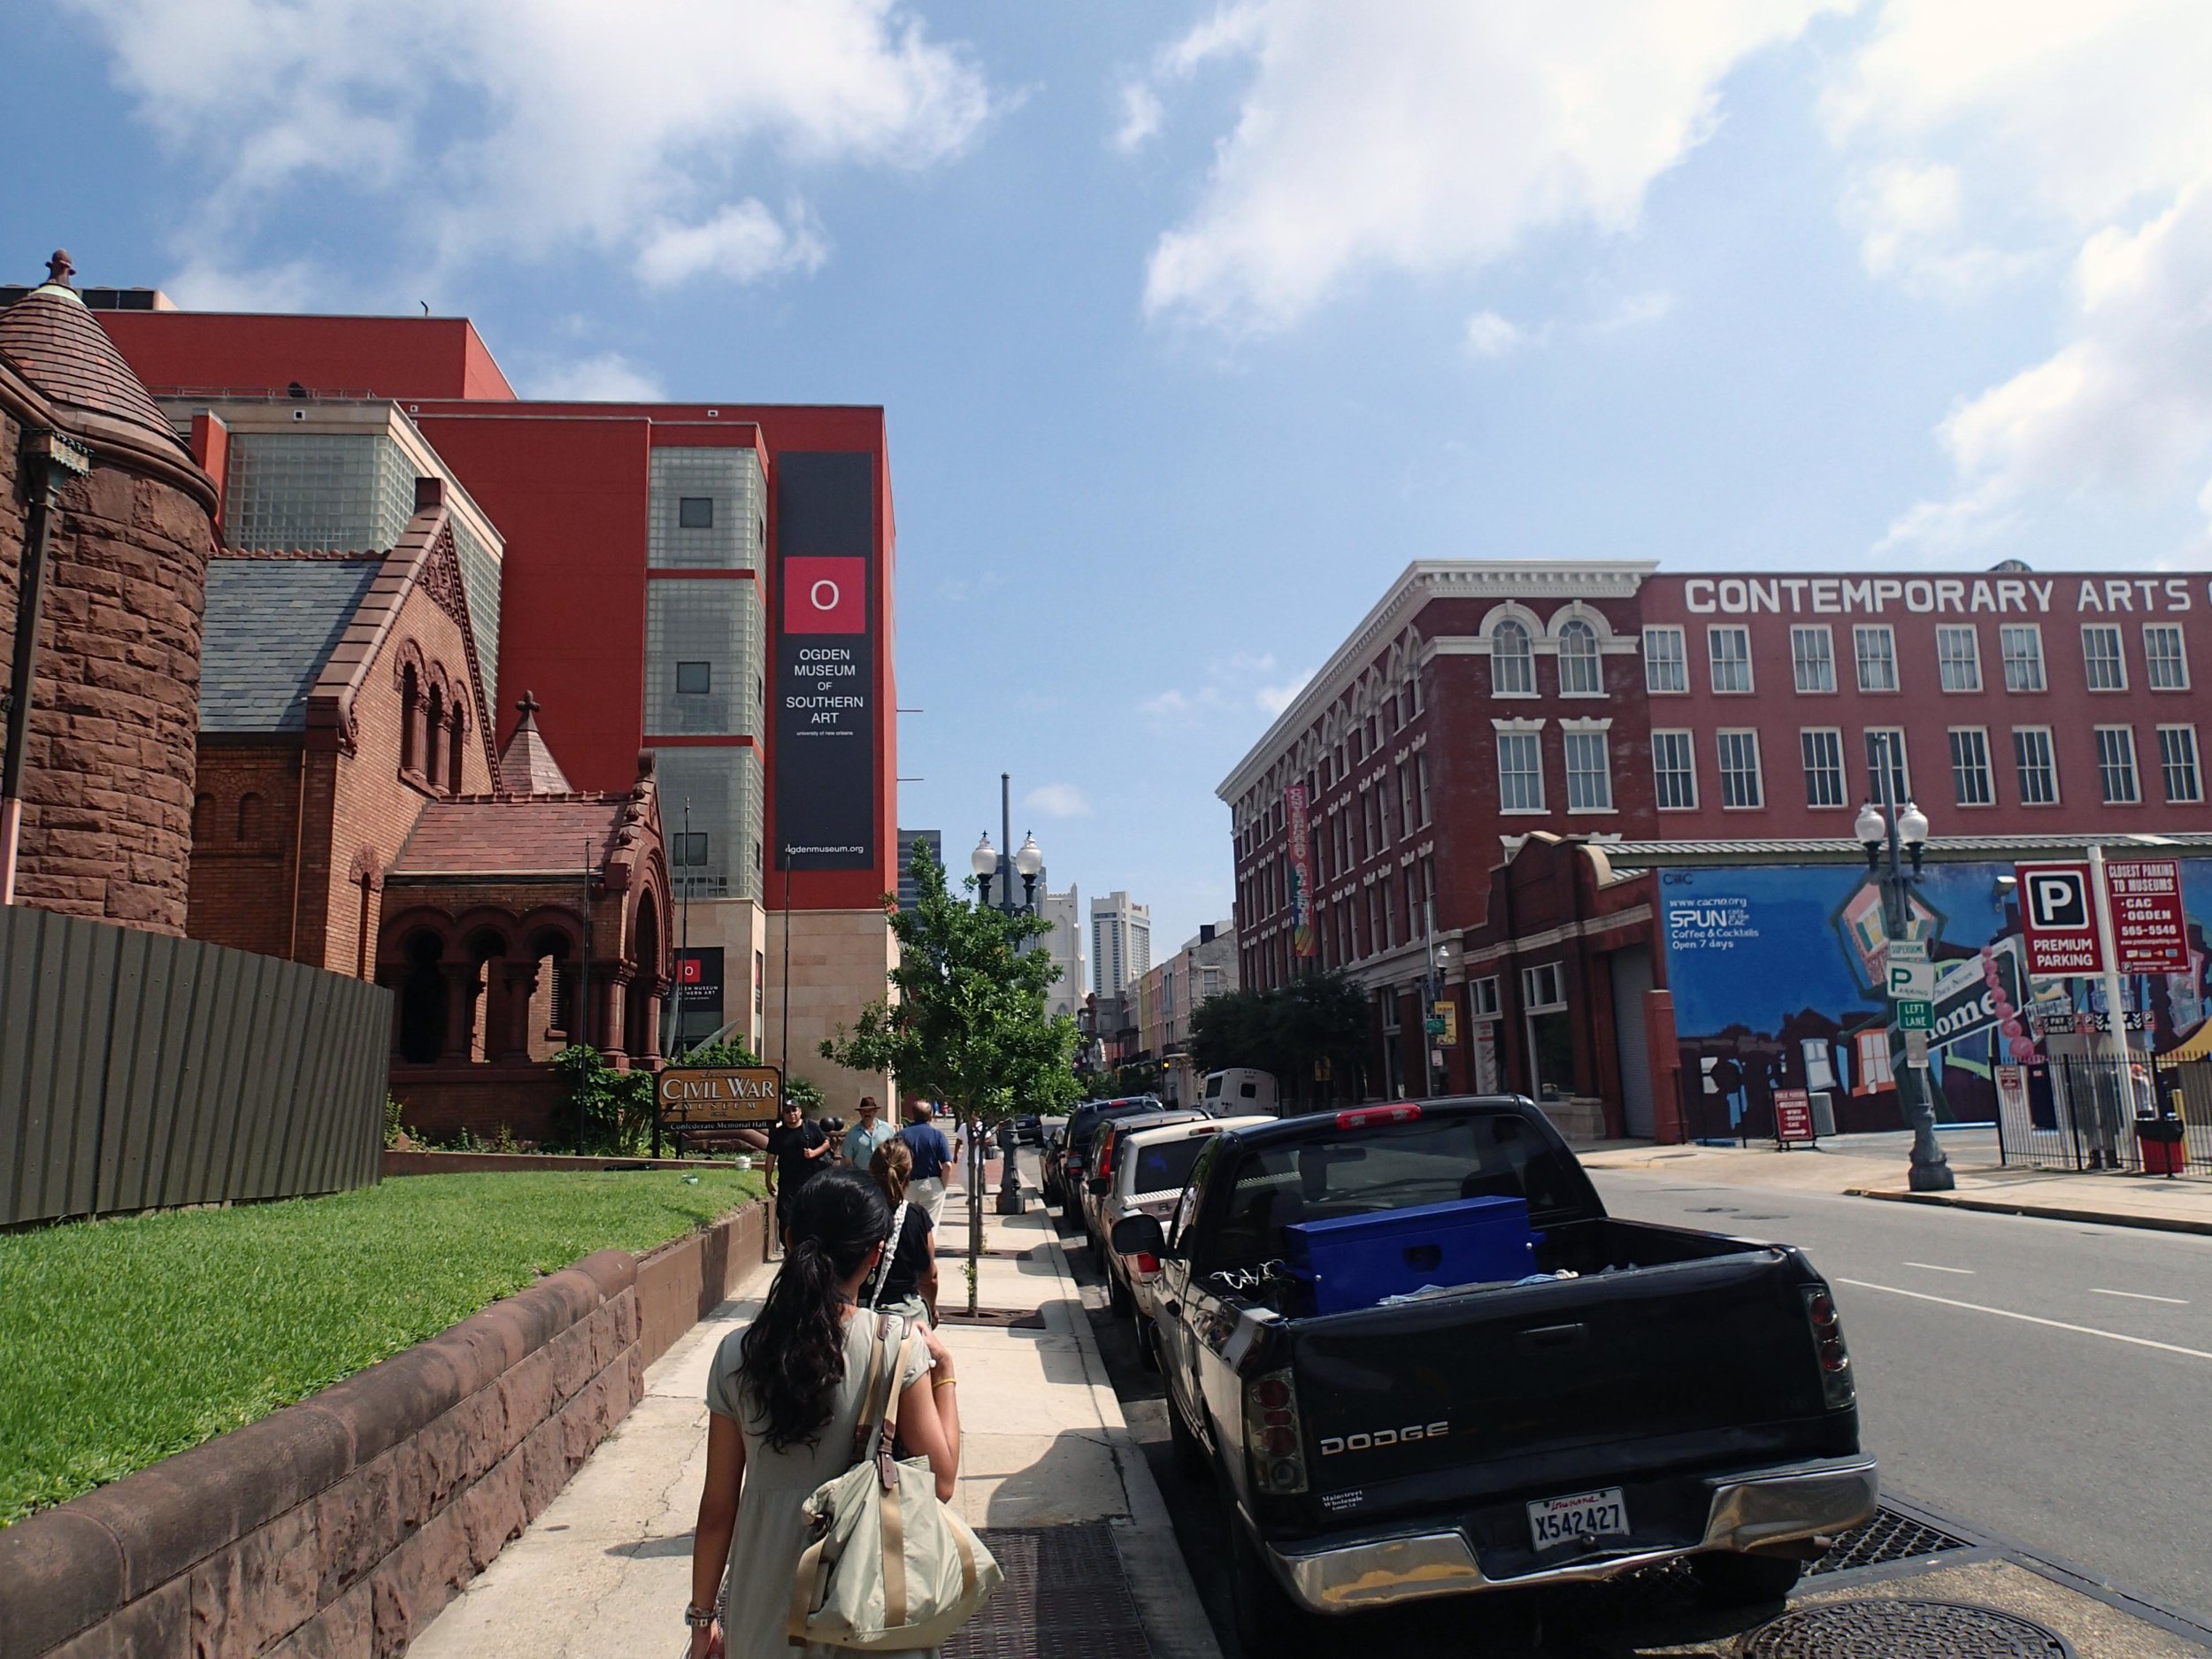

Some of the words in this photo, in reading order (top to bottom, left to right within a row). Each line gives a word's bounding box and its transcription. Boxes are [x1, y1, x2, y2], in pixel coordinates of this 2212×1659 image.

[810, 580, 840, 611] O
[1685, 579, 2054, 614] CONTEMPORARY
[2077, 579, 2193, 612] ARTS
[799, 649, 850, 661] OGDEN
[794, 664, 856, 677] MUSEUM
[817, 681, 833, 692] OF
[786, 695, 864, 709] SOUTHERN
[810, 712, 840, 724] ART
[2108, 864, 2140, 879] CLOSEST
[2142, 863, 2175, 877] PARKING
[2113, 879, 2126, 893] TO
[2128, 878, 2174, 892] MUSEUMS
[1669, 897, 1747, 908] www.cacno.org
[2039, 879, 2072, 921] P
[2125, 898, 2153, 910] CAC
[1670, 910, 1727, 928] SPUN
[2127, 910, 2171, 921] OGDEN
[1671, 929, 1705, 939] Coffee
[1708, 929, 1715, 938] &
[1716, 928, 1760, 938] Cocktails
[1672, 941, 1696, 950] Open
[1709, 939, 1734, 950] days
[2033, 938, 2093, 952] PREMIUM
[2037, 954, 2093, 967] PARKING
[1904, 1003, 1924, 1015] LEFT
[1905, 1017, 1927, 1027] LANE
[662, 1079, 722, 1100] CIVIL
[726, 1078, 775, 1098] WAR
[717, 1121, 750, 1130] Memorial
[1320, 1420, 1449, 1455] DODGE
[1322, 1490, 1363, 1502] Mainstreet
[1324, 1496, 1363, 1508] Wholesale
[1534, 1504, 1619, 1541] X542427
